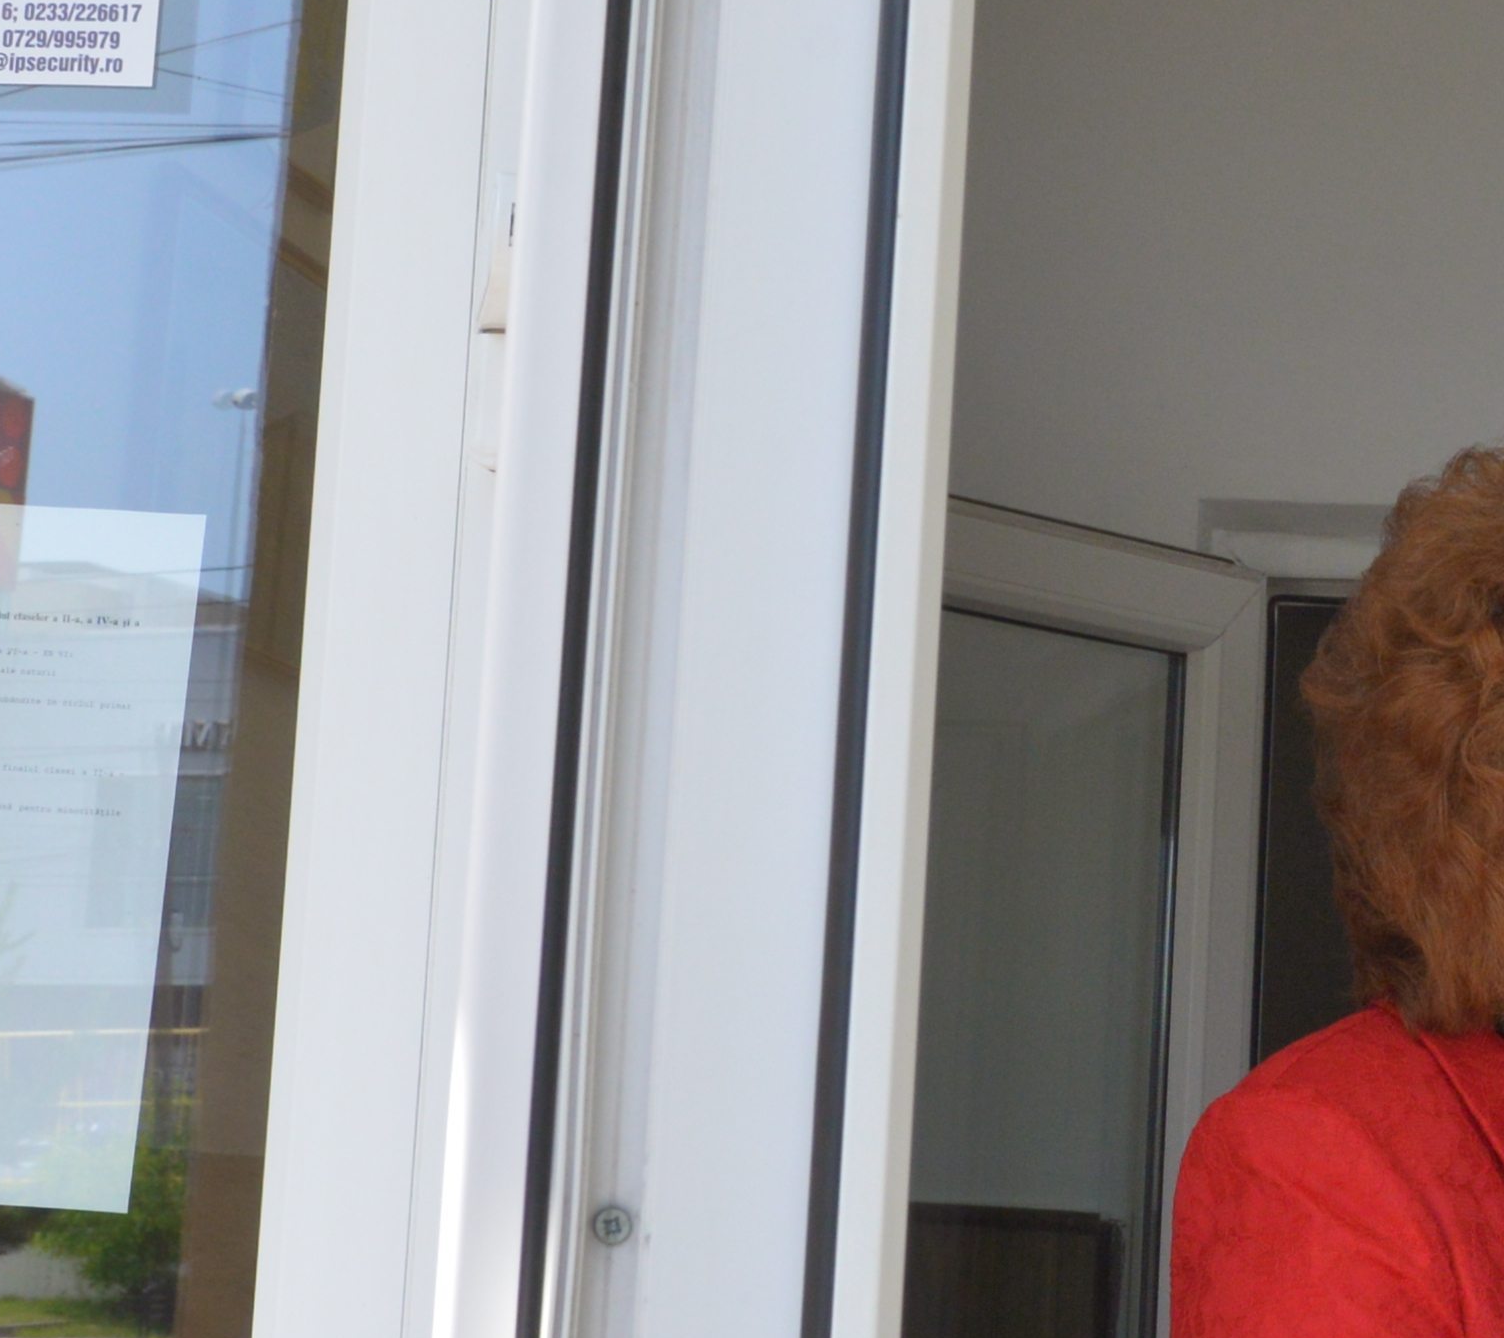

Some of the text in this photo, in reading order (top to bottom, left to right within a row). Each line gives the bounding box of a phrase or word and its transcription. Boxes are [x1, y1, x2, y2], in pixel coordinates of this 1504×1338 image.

[24, 2, 143, 22] 0233/226617
[2, 29, 122, 49] 0729/995979
[13, 611, 49, 622] claselor
